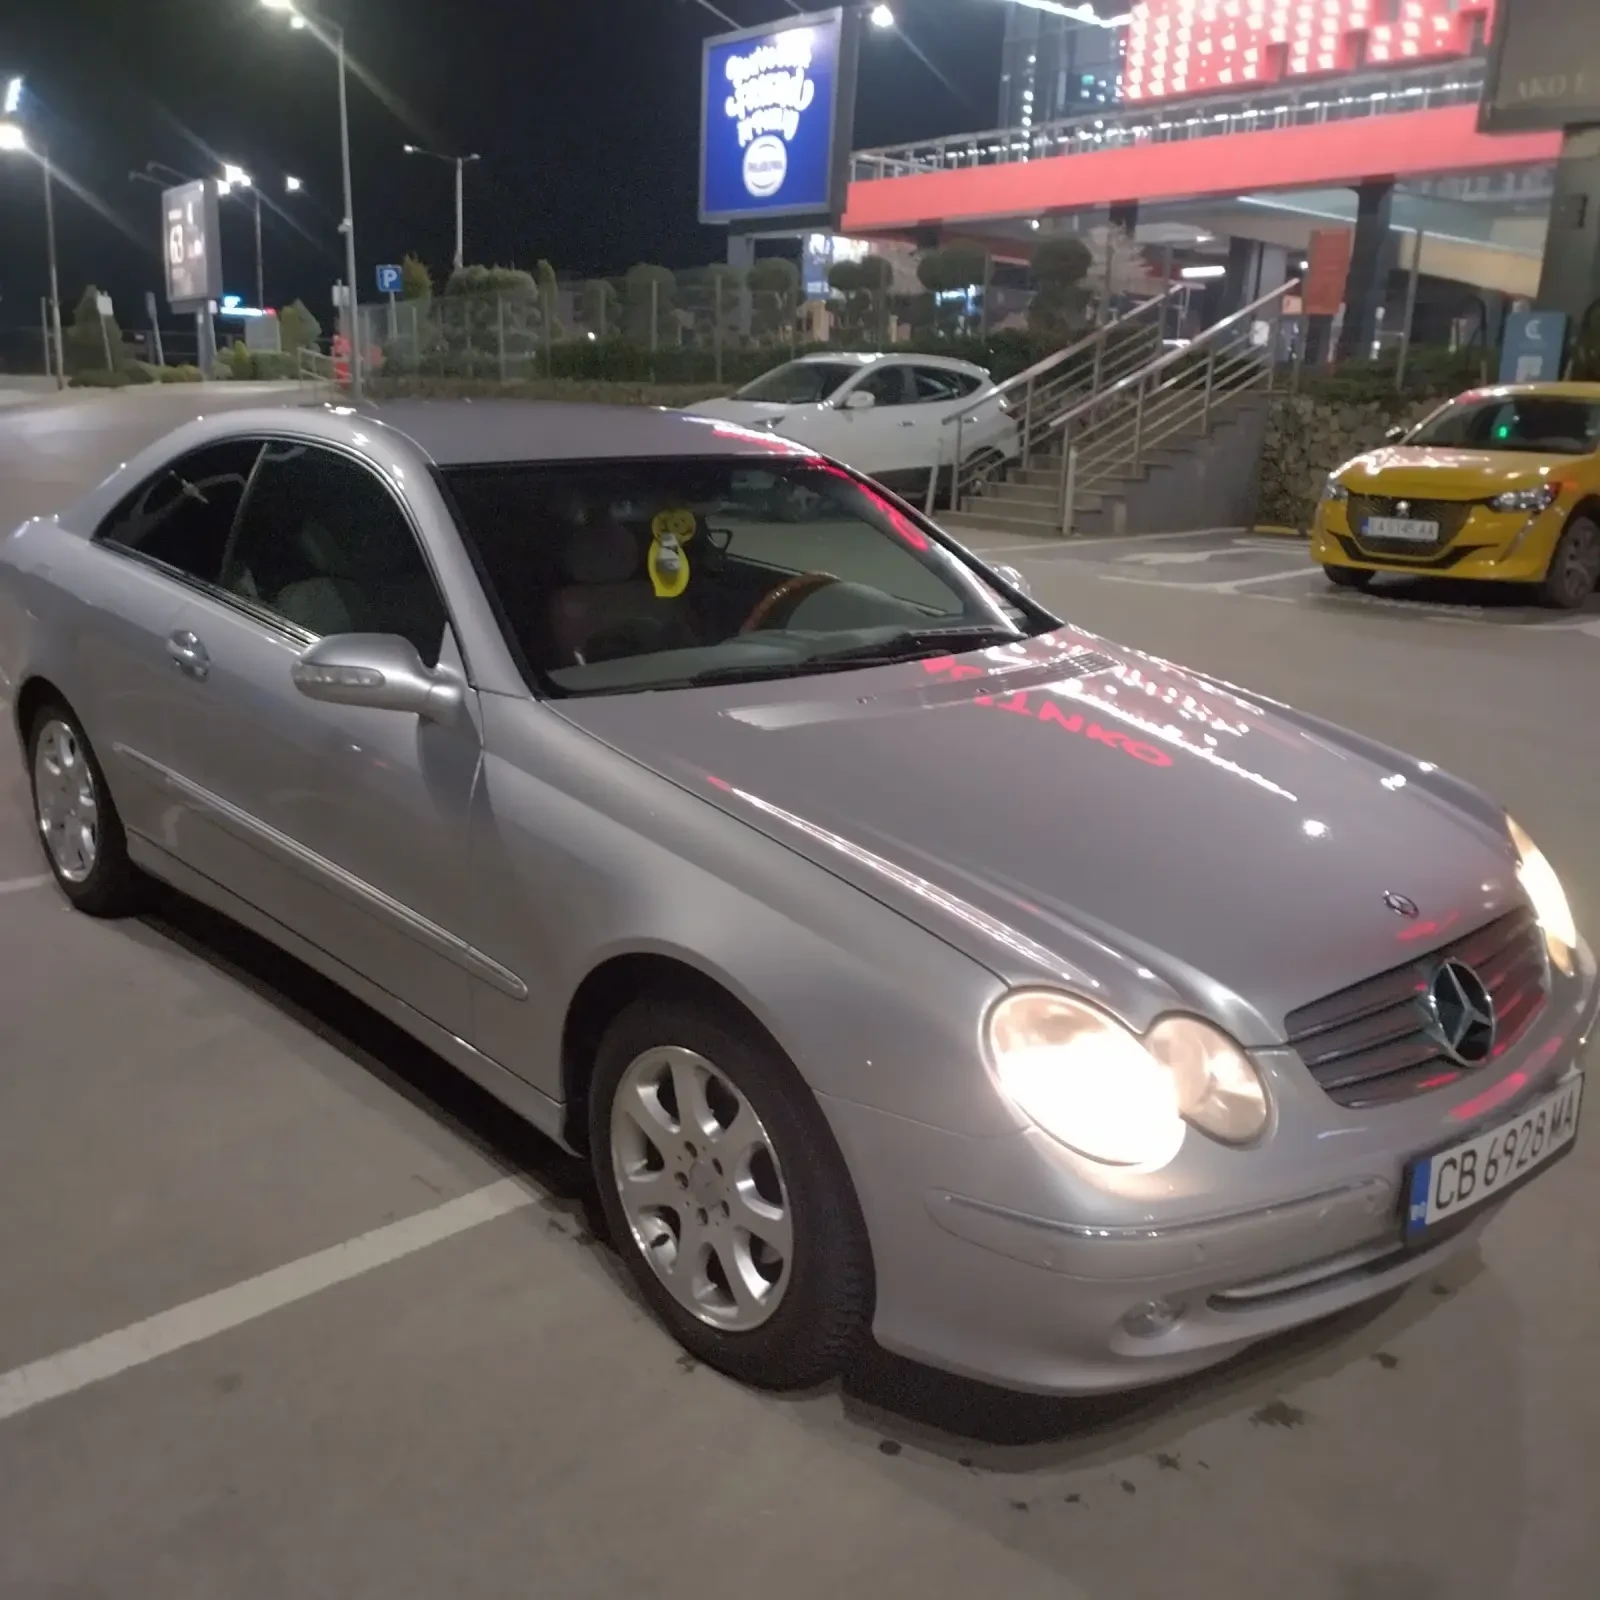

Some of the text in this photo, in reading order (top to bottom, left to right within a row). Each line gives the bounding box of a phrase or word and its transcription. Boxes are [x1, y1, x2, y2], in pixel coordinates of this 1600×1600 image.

[383, 269, 398, 289] P
[1435, 1148, 1478, 1210] CB
[1483, 1110, 1547, 1187] 6928
